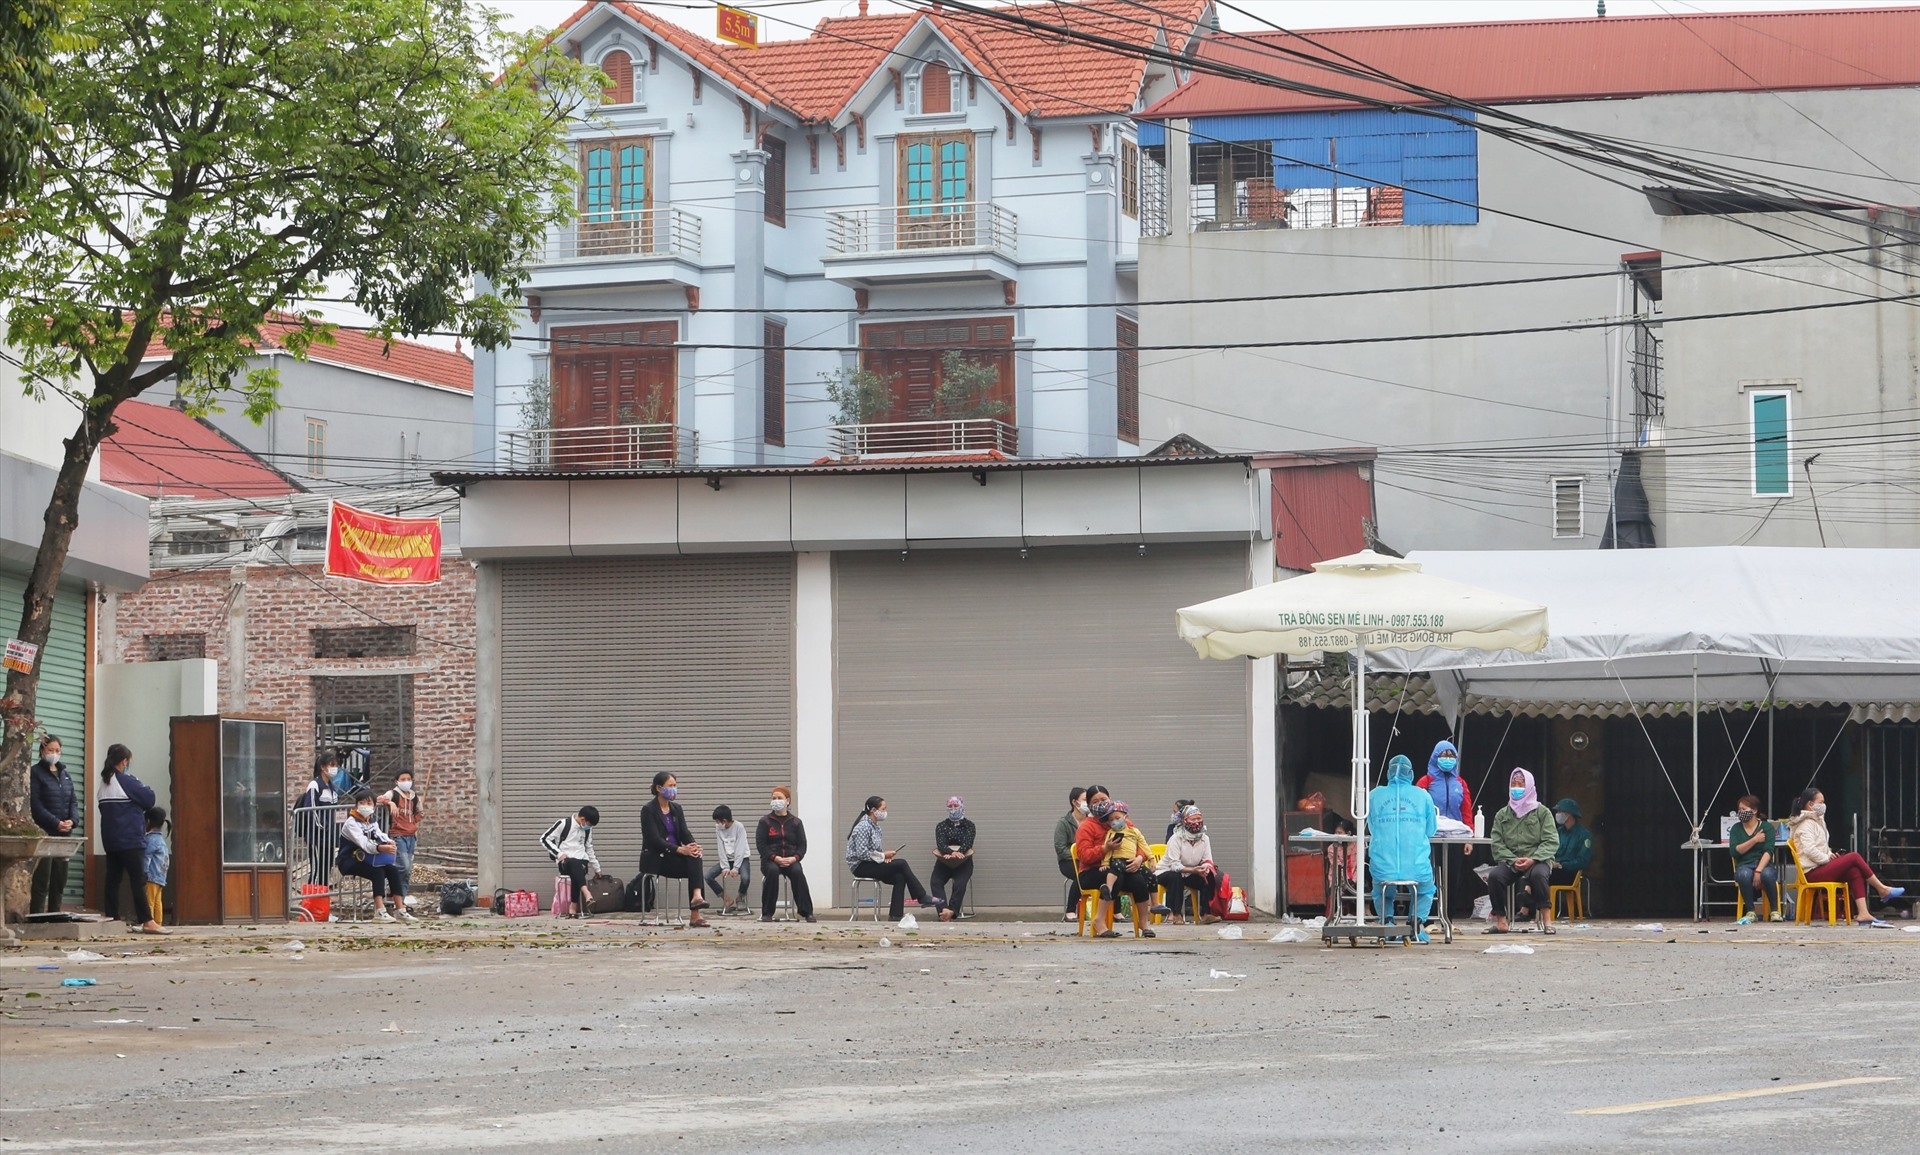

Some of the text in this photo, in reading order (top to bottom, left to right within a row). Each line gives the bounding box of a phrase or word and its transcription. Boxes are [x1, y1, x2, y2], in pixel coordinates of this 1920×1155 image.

[725, 16, 750, 38] 5.5m
[1327, 613, 1345, 625] SEN
[1363, 614, 1384, 626] LINH
[1391, 614, 1444, 627] 0987.553.188
